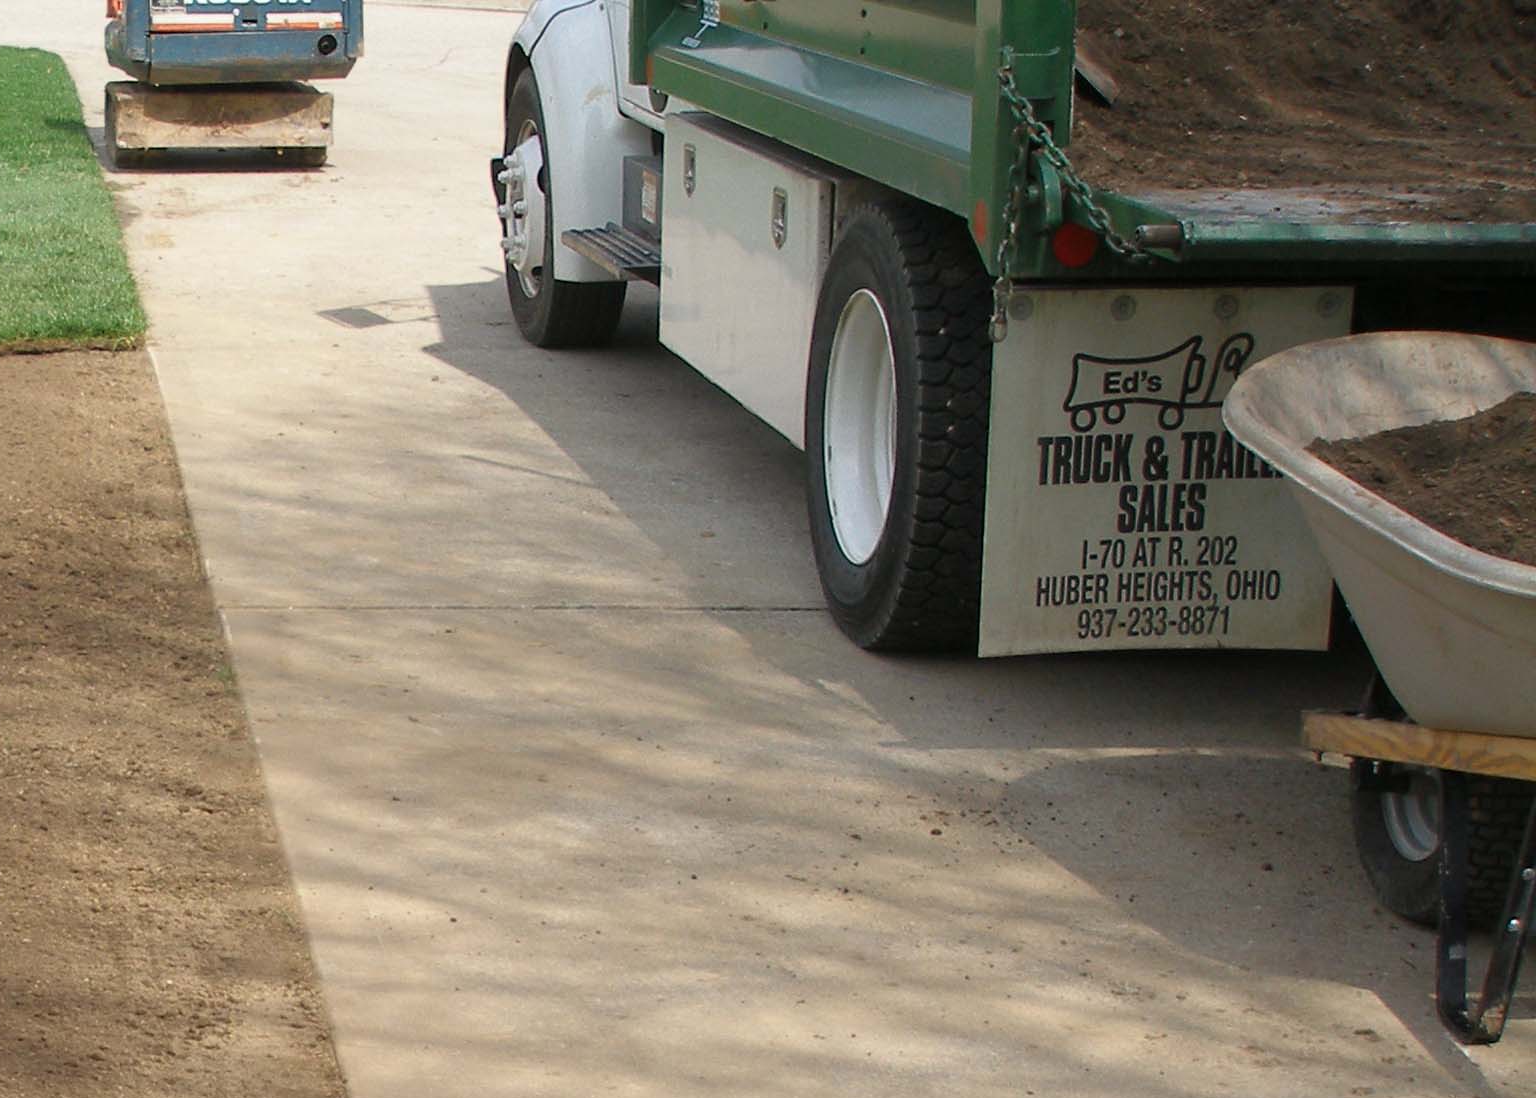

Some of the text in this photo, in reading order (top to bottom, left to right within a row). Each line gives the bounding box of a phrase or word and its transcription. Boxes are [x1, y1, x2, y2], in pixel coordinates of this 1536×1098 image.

[1103, 371, 1163, 394] Ed's
[1038, 431, 1285, 486] TRUCK & TRAIL
[1117, 482, 1207, 534] SALES
[1081, 536, 1238, 569] I-70 AT R. 202
[1036, 569, 1280, 607] HUBER HEIGHTS, OHIO
[1077, 605, 1230, 640] 937-233-8871
